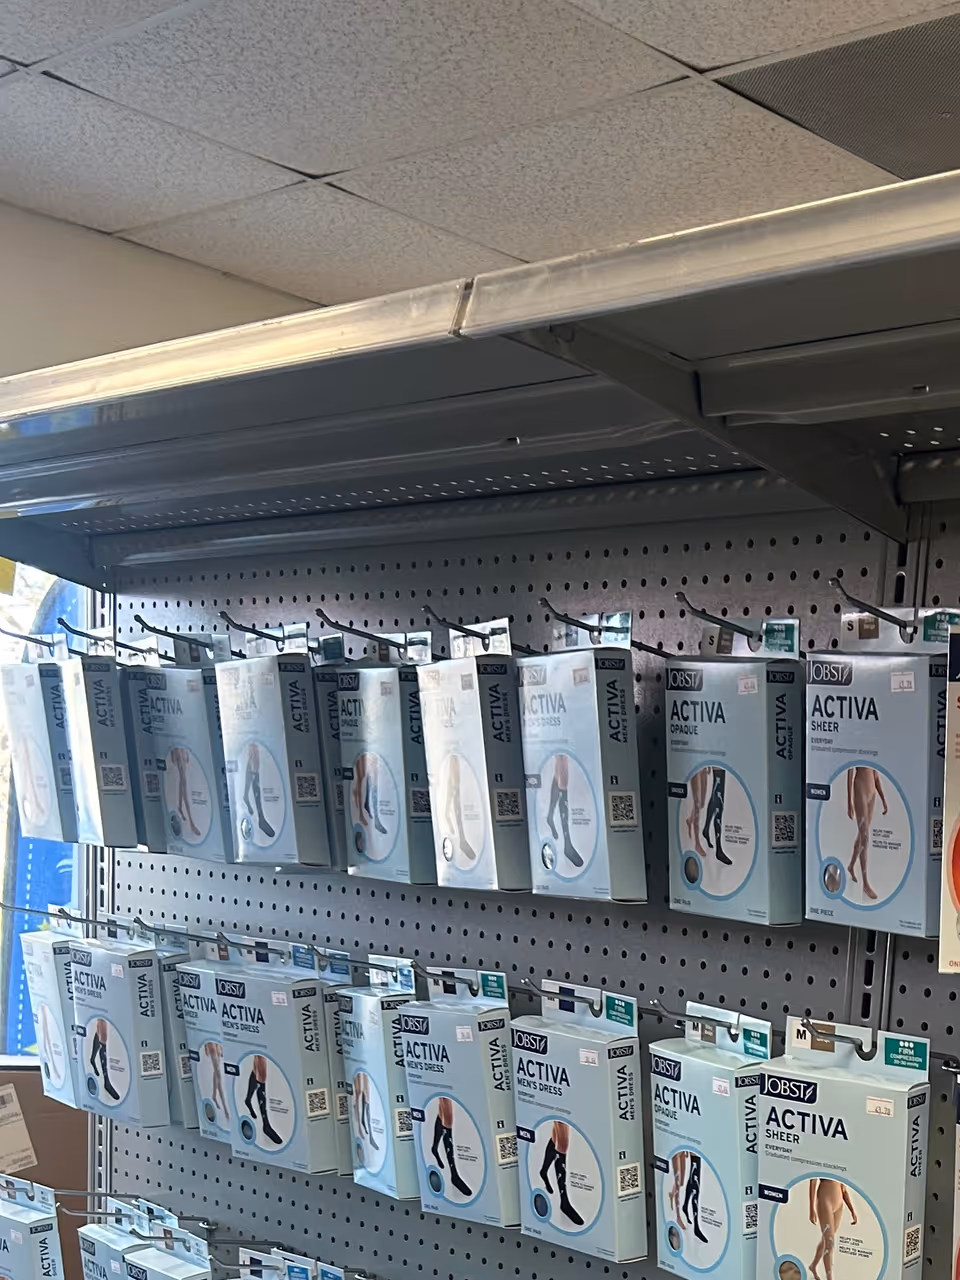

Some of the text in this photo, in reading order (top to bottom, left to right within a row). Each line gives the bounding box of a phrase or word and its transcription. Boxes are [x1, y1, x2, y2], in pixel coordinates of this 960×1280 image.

[92, 679, 109, 727] ACTIVA
[288, 679, 304, 732] ACTIVA
[489, 683, 505, 743] ACTIVA
[606, 679, 621, 743] ACTIVA
[670, 700, 726, 724] ACTIVA
[811, 694, 879, 721] ACTIVA
[670, 724, 698, 735] OPAQUE
[775, 693, 788, 760] ACTIVA
[811, 721, 839, 732] SHEER
[74, 970, 106, 991] ACTIVA
[138, 974, 150, 1017] ACTIVA
[183, 993, 217, 1014] ACTIVA
[222, 1002, 265, 1025] ACTIVA
[240, 1023, 259, 1034] DRESS
[301, 1004, 315, 1052] ACTIVA
[513, 1029, 541, 1051] JOBST
[406, 1040, 450, 1063] ACTIVA
[489, 1037, 505, 1091] ACTIVA
[899, 1047, 914, 1055] FIRM
[424, 1062, 445, 1073] DRESS
[517, 1057, 570, 1087] ACTIVA
[517, 1077, 563, 1097] MEN'S DRESS
[617, 1065, 629, 1121] ACTIVA
[763, 1073, 808, 1098] JOBST
[654, 1083, 701, 1116] ACTIVA
[654, 1105, 678, 1121] OPAQUE
[745, 1095, 758, 1154] ACTIVA
[766, 1106, 848, 1140] ACTIVA
[765, 1129, 800, 1144] SHEER
[765, 1144, 793, 1154] EVERYDAY
[910, 1115, 920, 1178] ACTIVA
[39, 1237, 52, 1277] ACTIVA
